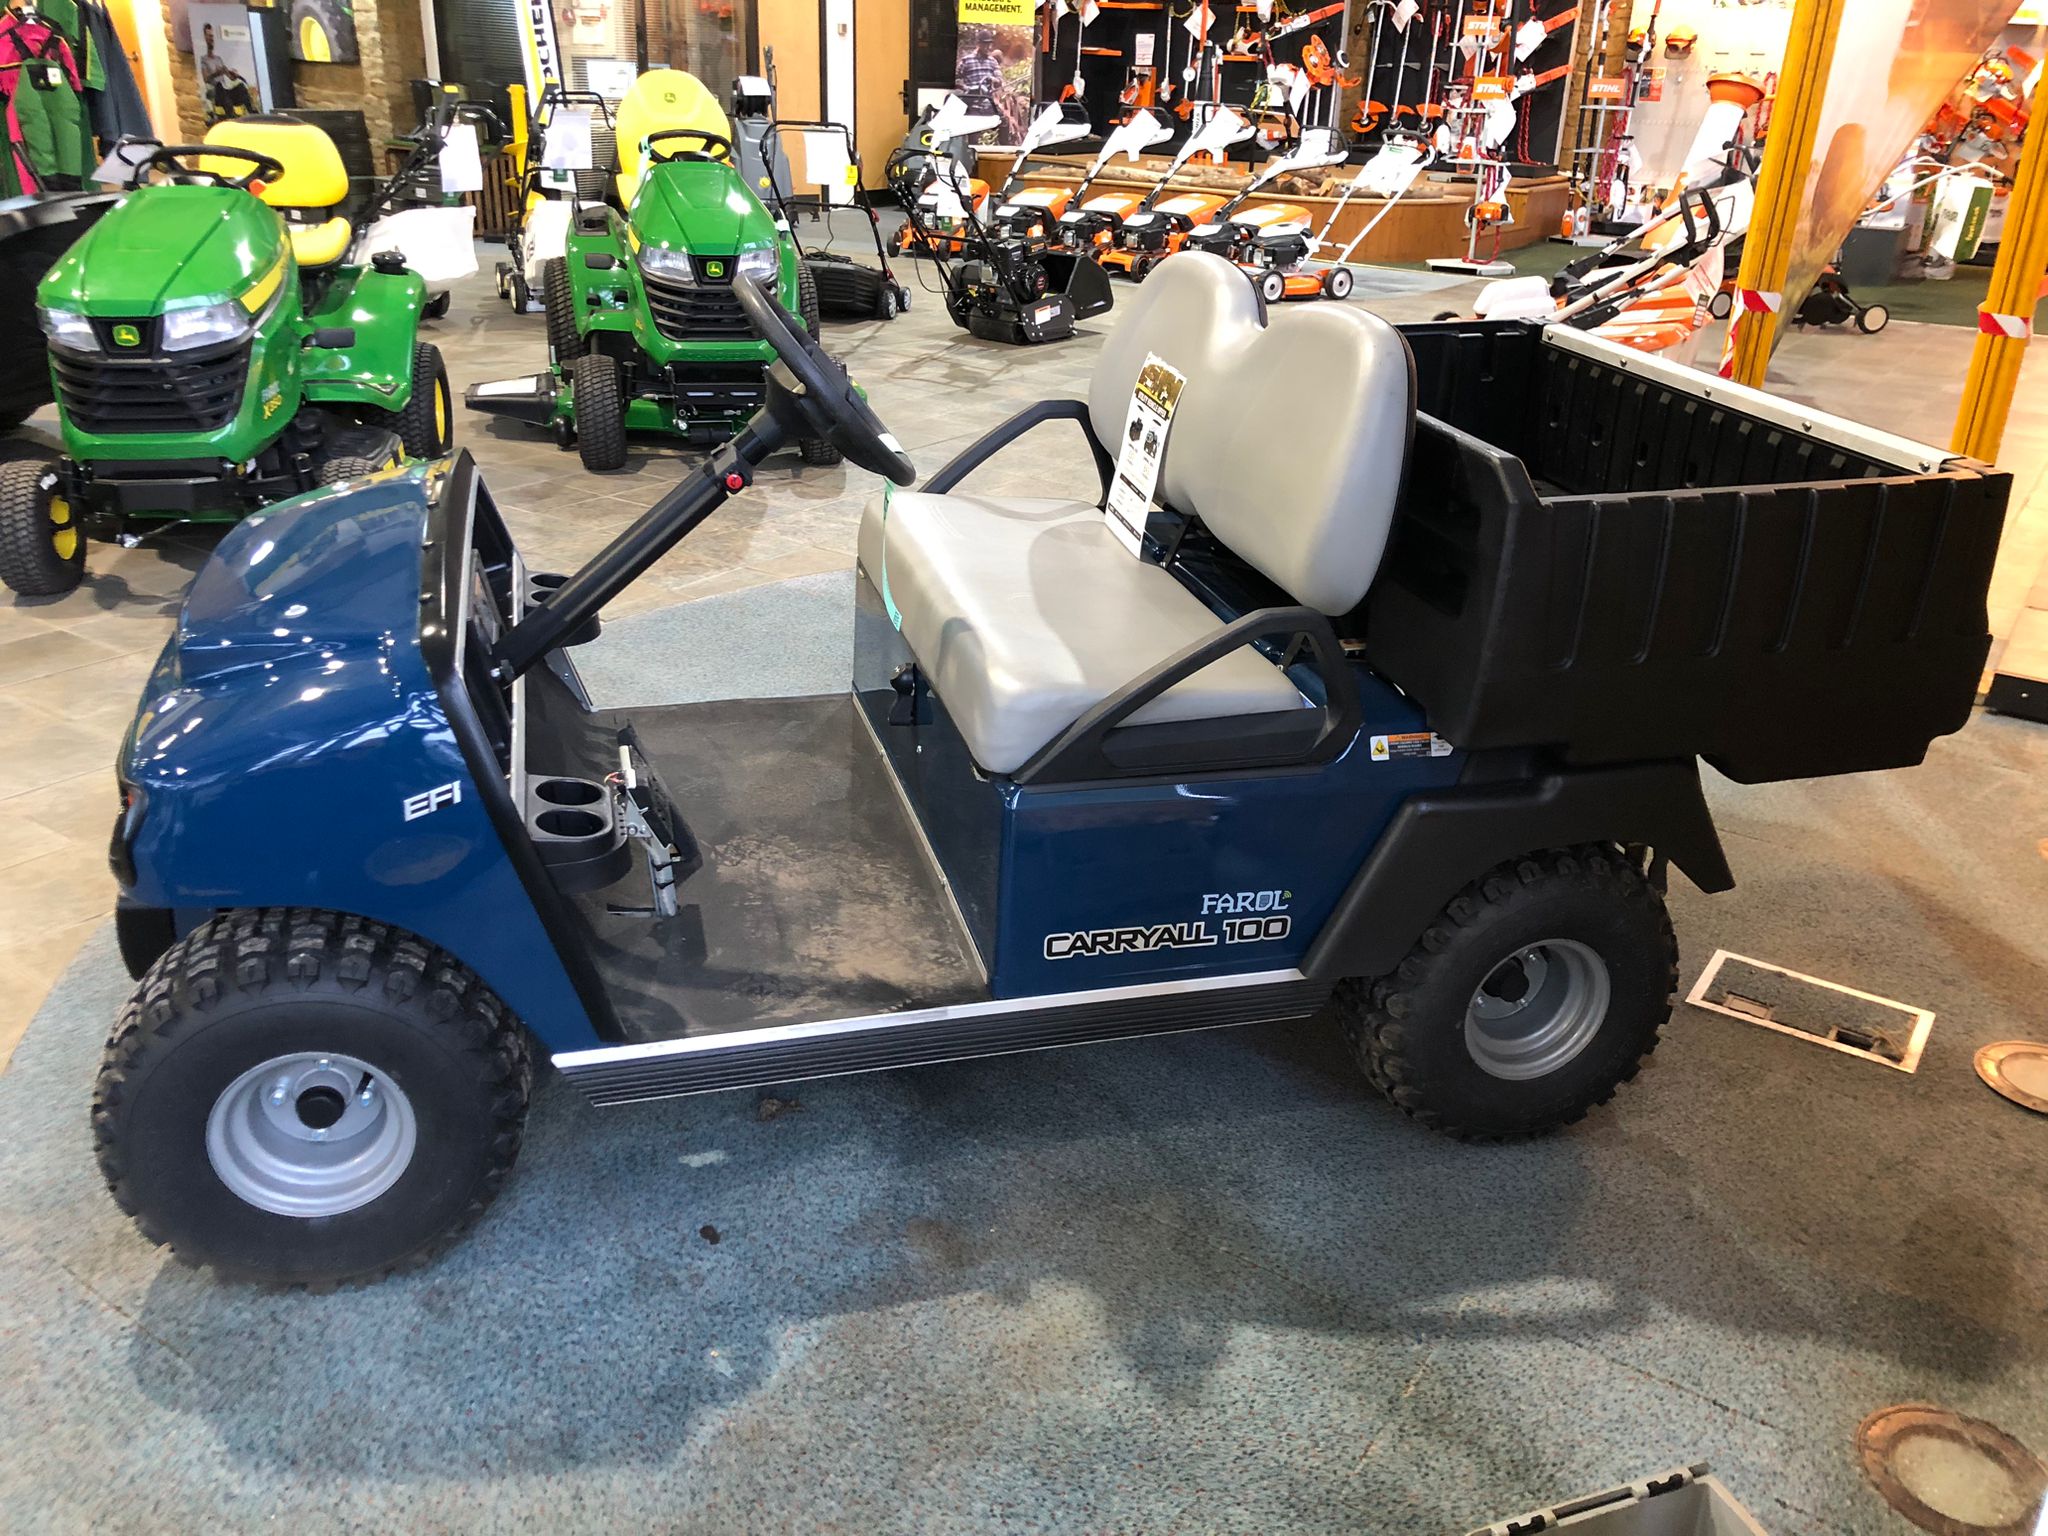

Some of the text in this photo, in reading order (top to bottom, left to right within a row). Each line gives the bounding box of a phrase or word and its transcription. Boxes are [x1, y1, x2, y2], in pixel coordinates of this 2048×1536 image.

[965, 3, 1022, 13] MANAGEMENT.
[1591, 84, 1620, 92] STIHL
[403, 780, 461, 821] EFI
[1201, 890, 1289, 914] FAROL
[1044, 915, 1291, 960] CARRYALL 100
